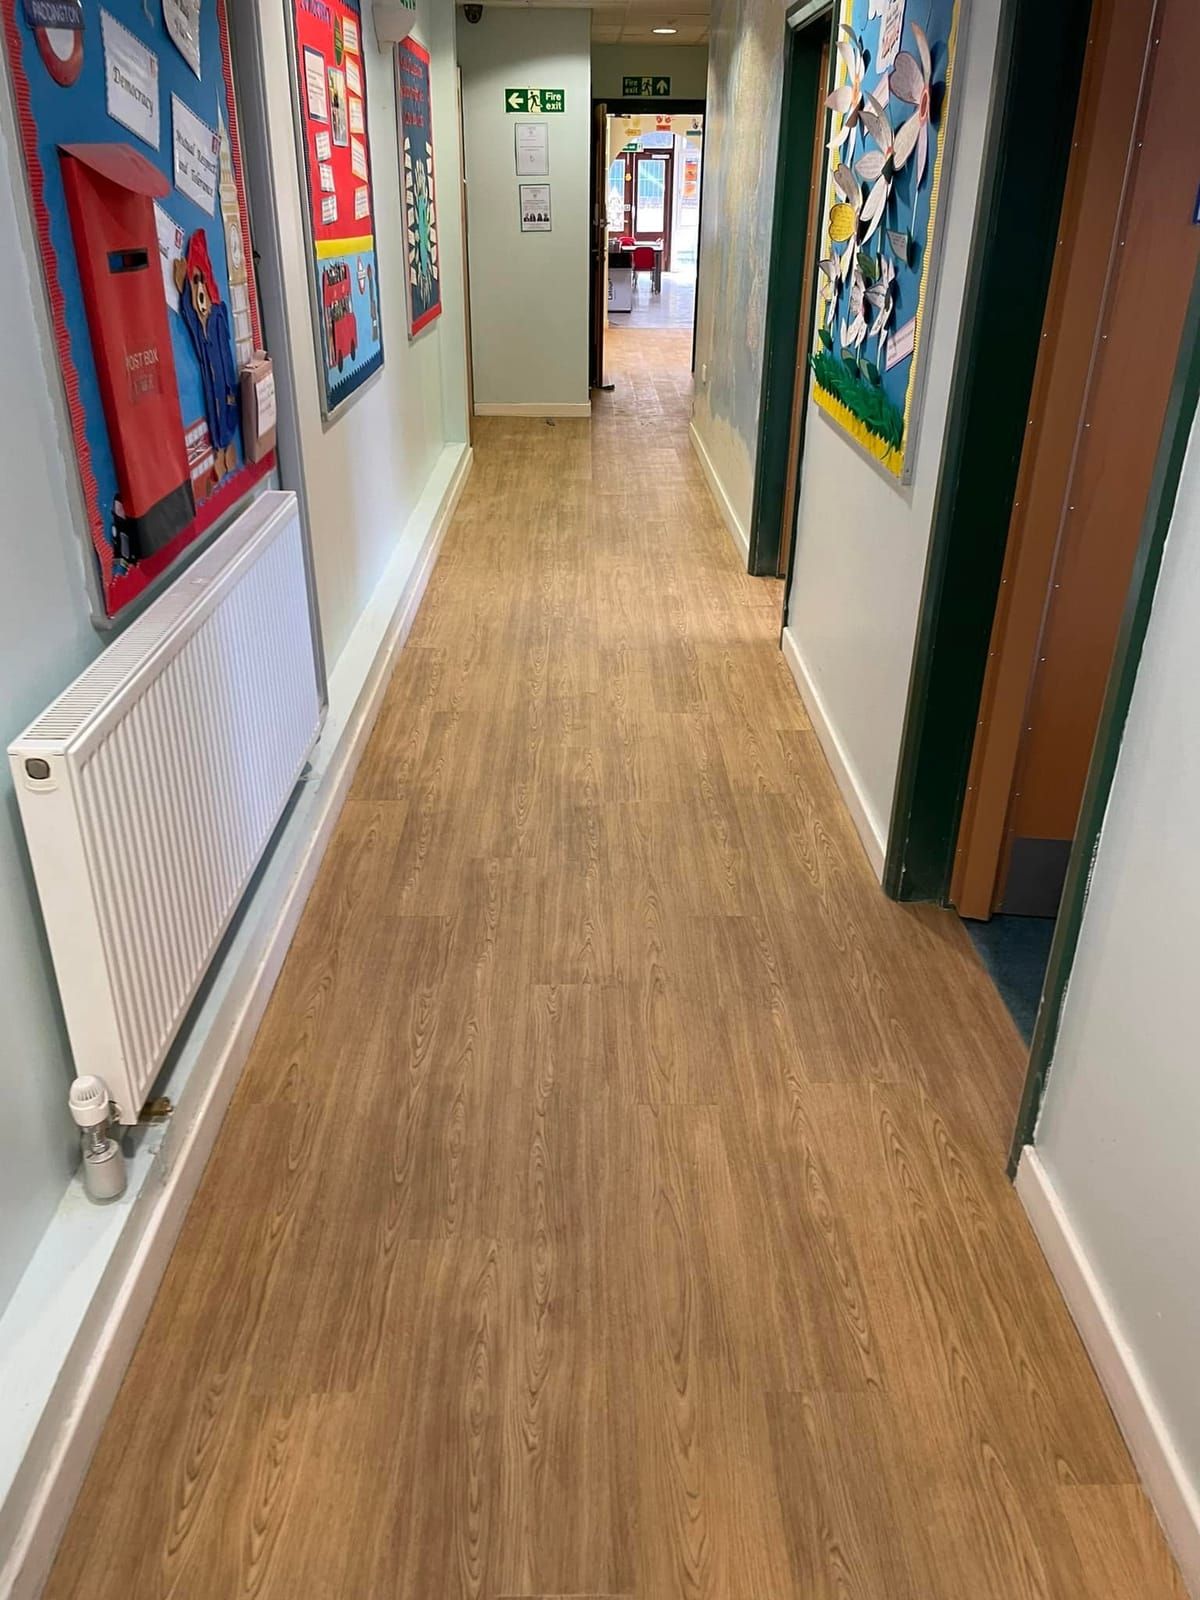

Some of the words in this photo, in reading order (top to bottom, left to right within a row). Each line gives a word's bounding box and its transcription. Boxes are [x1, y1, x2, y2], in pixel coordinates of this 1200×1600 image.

[624, 78, 638, 87] Fire
[113, 65, 153, 118] Democracy
[545, 91, 562, 101] Fire
[545, 101, 562, 111] exit
[126, 352, 142, 374] POST
[143, 348, 159, 366] BOX
